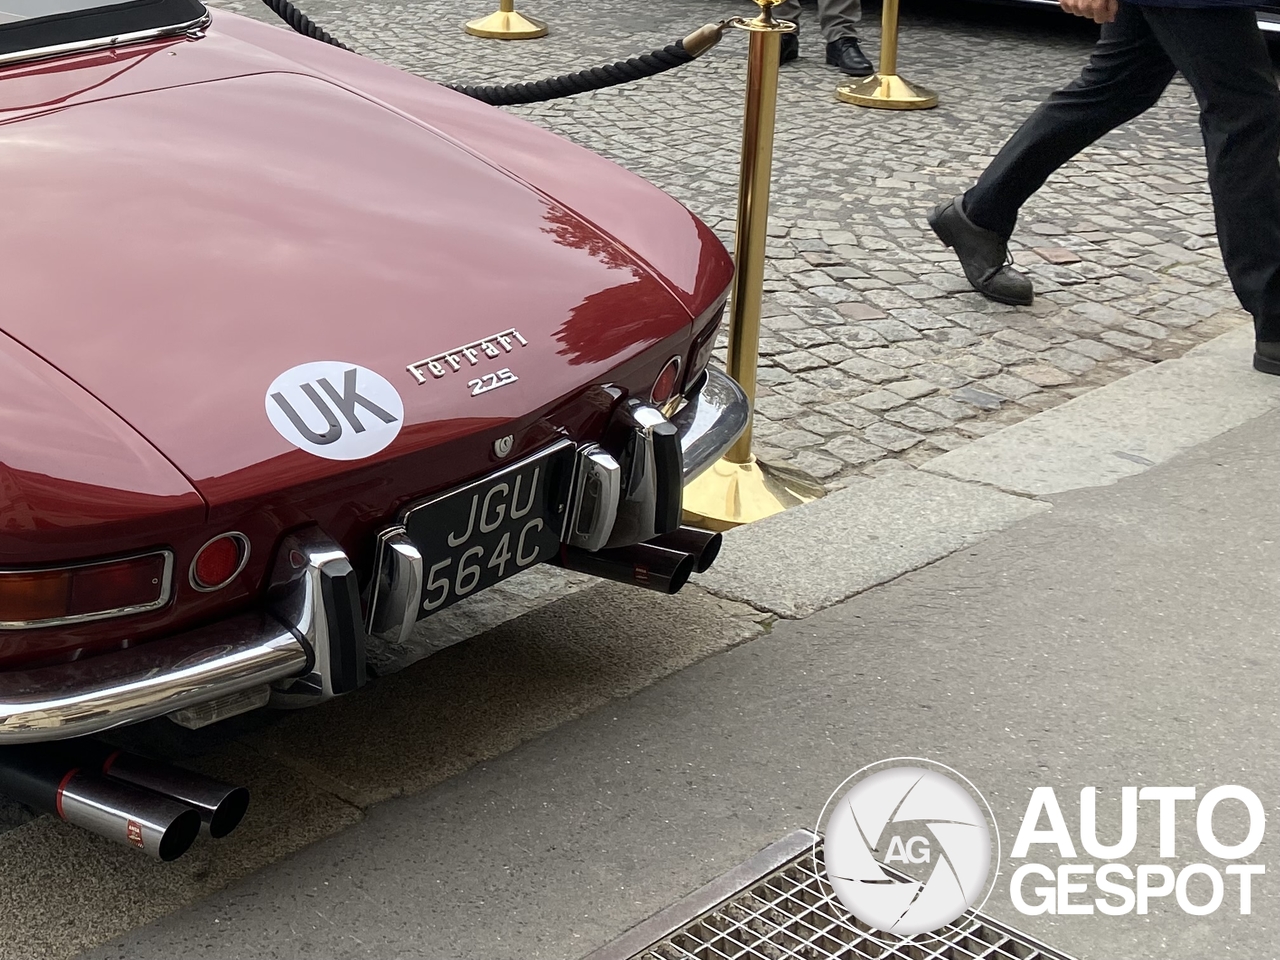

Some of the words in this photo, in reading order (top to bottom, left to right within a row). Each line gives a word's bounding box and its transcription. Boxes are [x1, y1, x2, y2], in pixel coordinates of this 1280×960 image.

[406, 327, 528, 385] Ferrari
[467, 367, 519, 397] 275
[270, 368, 398, 446] UK
[447, 466, 540, 547] JGU
[422, 517, 544, 611] 564C
